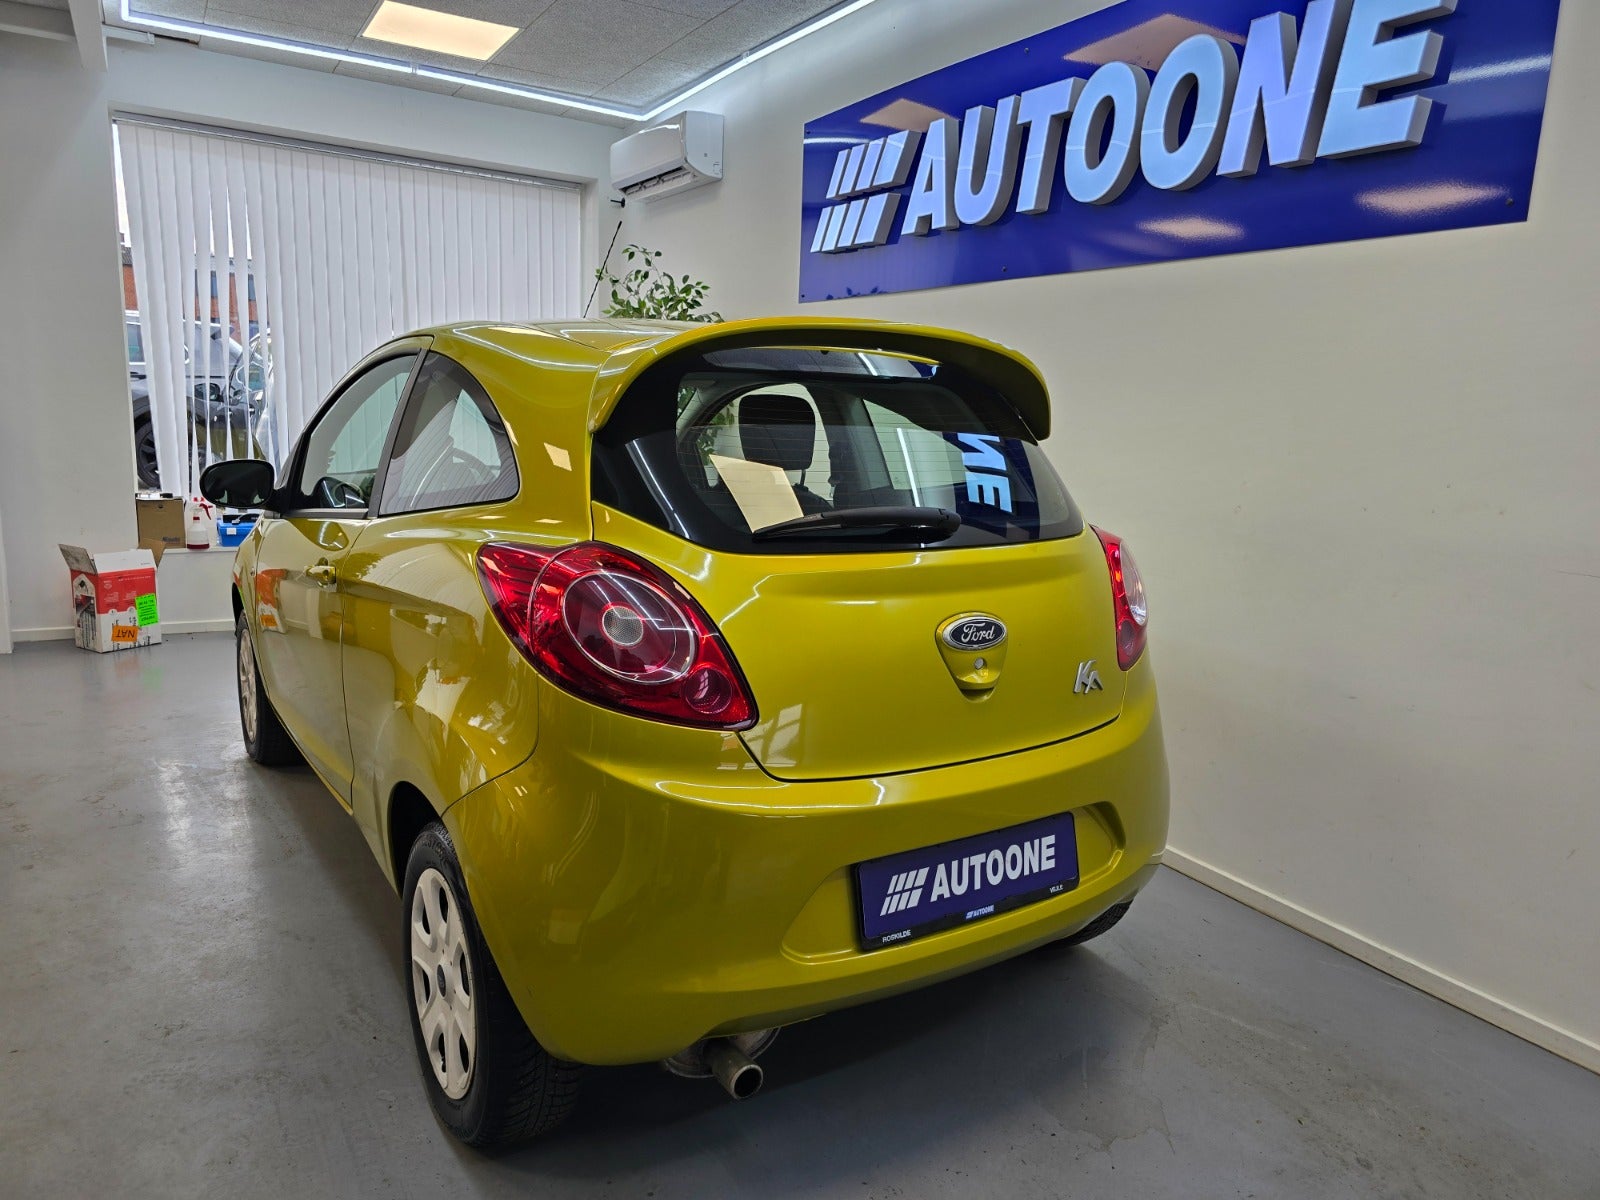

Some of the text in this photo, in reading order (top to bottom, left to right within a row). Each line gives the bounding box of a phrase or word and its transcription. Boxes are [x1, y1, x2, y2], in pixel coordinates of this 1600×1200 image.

[901, 0, 1457, 237] AUTOONE
[115, 629, 136, 638] NAT
[961, 622, 996, 644] Ford
[930, 834, 1056, 902] AUTOONE
[972, 904, 995, 918] AUTOONE
[882, 929, 912, 944] ROSKILDE
